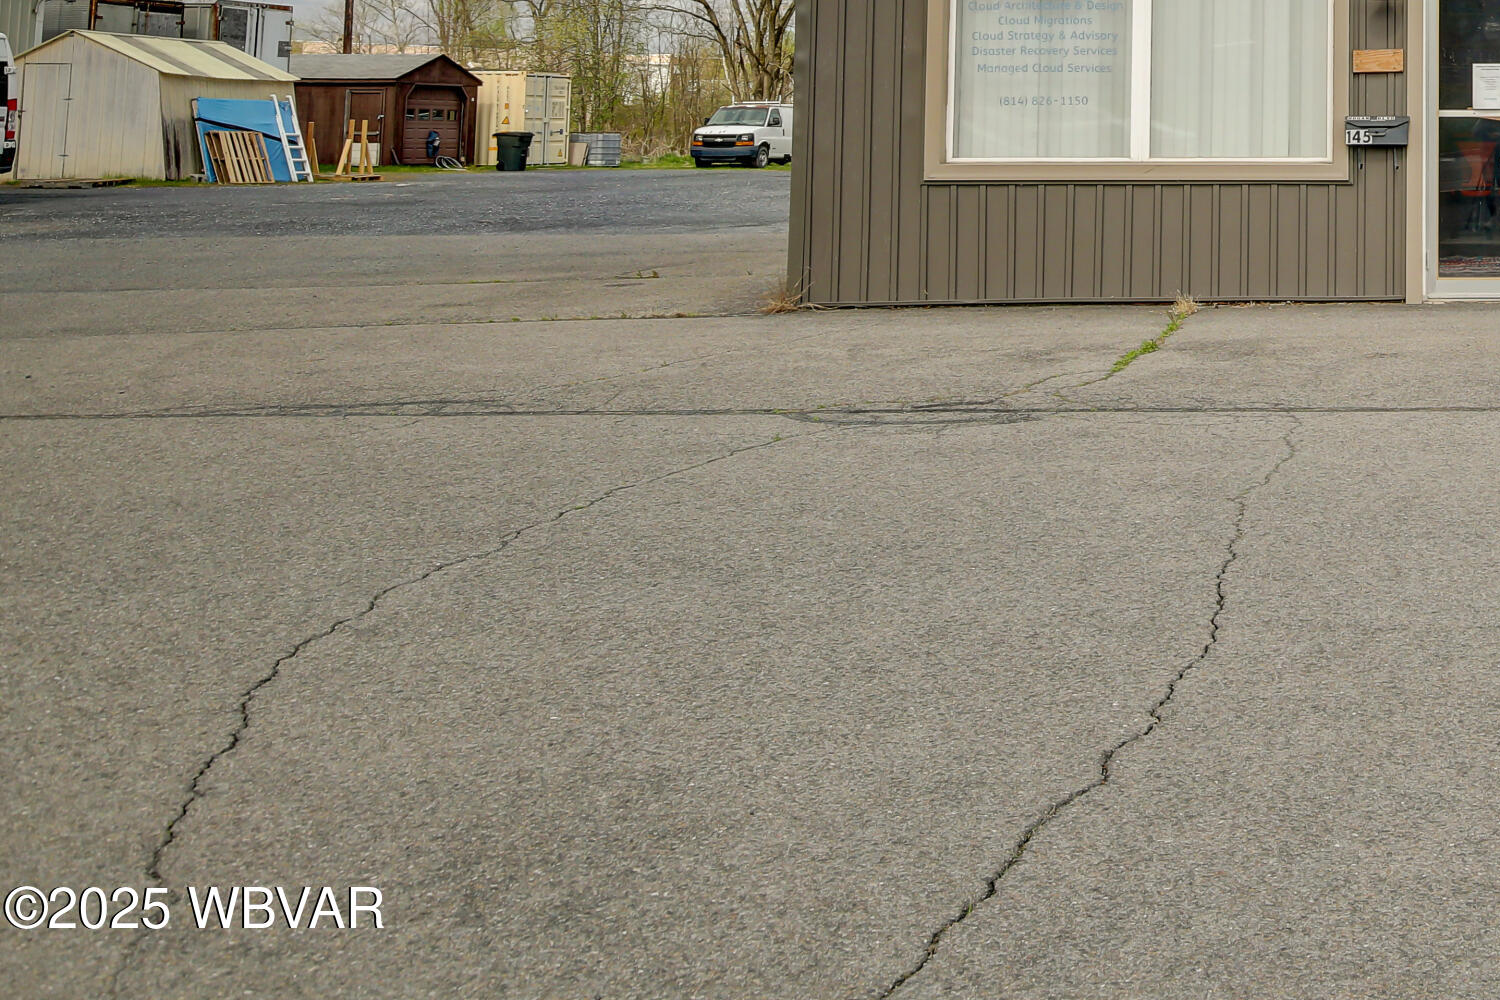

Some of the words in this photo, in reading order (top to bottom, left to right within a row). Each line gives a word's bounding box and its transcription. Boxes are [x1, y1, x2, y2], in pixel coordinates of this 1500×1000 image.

[968, 1, 1000, 11] Cloud
[1087, 0, 1124, 12] Design
[998, 16, 1030, 25] Cloud
[1035, 16, 1093, 28] Migrations
[971, 32, 1003, 41] Cloud
[1007, 31, 1054, 43] Strategy
[1059, 31, 1065, 40] &
[1070, 31, 1118, 43] Advisory
[971, 47, 1016, 56] Disaster
[1020, 47, 1069, 58] Recovery
[1073, 46, 1118, 56] Services
[977, 64, 1028, 75] Managed
[1032, 63, 1064, 73] Cloud
[1067, 63, 1112, 73] Services
[999, 96, 1028, 107] (814)
[1346, 130, 1371, 143] 145
